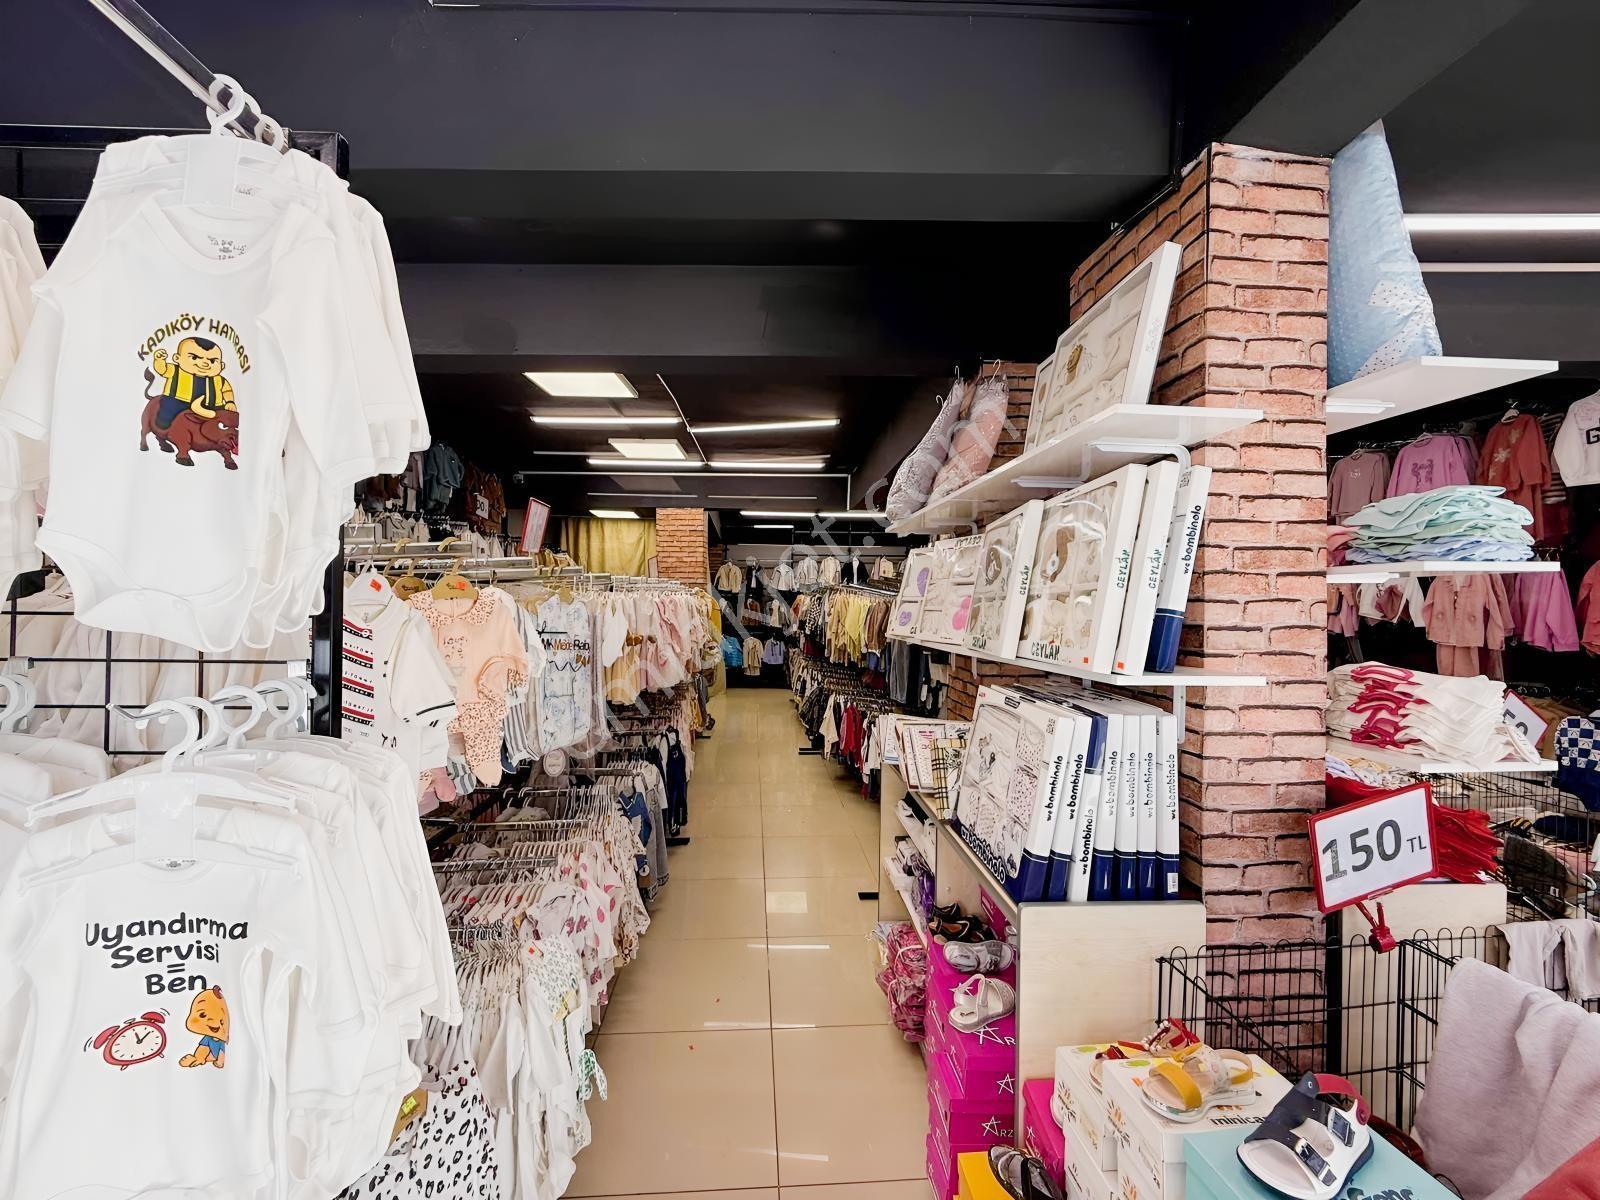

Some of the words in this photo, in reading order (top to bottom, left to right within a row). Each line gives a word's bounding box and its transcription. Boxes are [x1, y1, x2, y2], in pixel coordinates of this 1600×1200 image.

[137, 313, 205, 361] KADIKÖY
[209, 318, 251, 374] HATIRASI
[1181, 504, 1202, 560] bombinolo
[1044, 755, 1064, 808] bombinolo
[1067, 754, 1084, 808] bombinolo
[1106, 750, 1118, 804] bombinolo
[1126, 752, 1136, 806] bombinolo
[1080, 809, 1094, 862] bombinolo
[1322, 819, 1402, 882] 150
[1406, 835, 1427, 852] TL
[86, 912, 249, 950] Uyandırma
[111, 940, 219, 969] Servisi
[145, 973, 208, 996] Ben
[1210, 1114, 1266, 1126] minica
